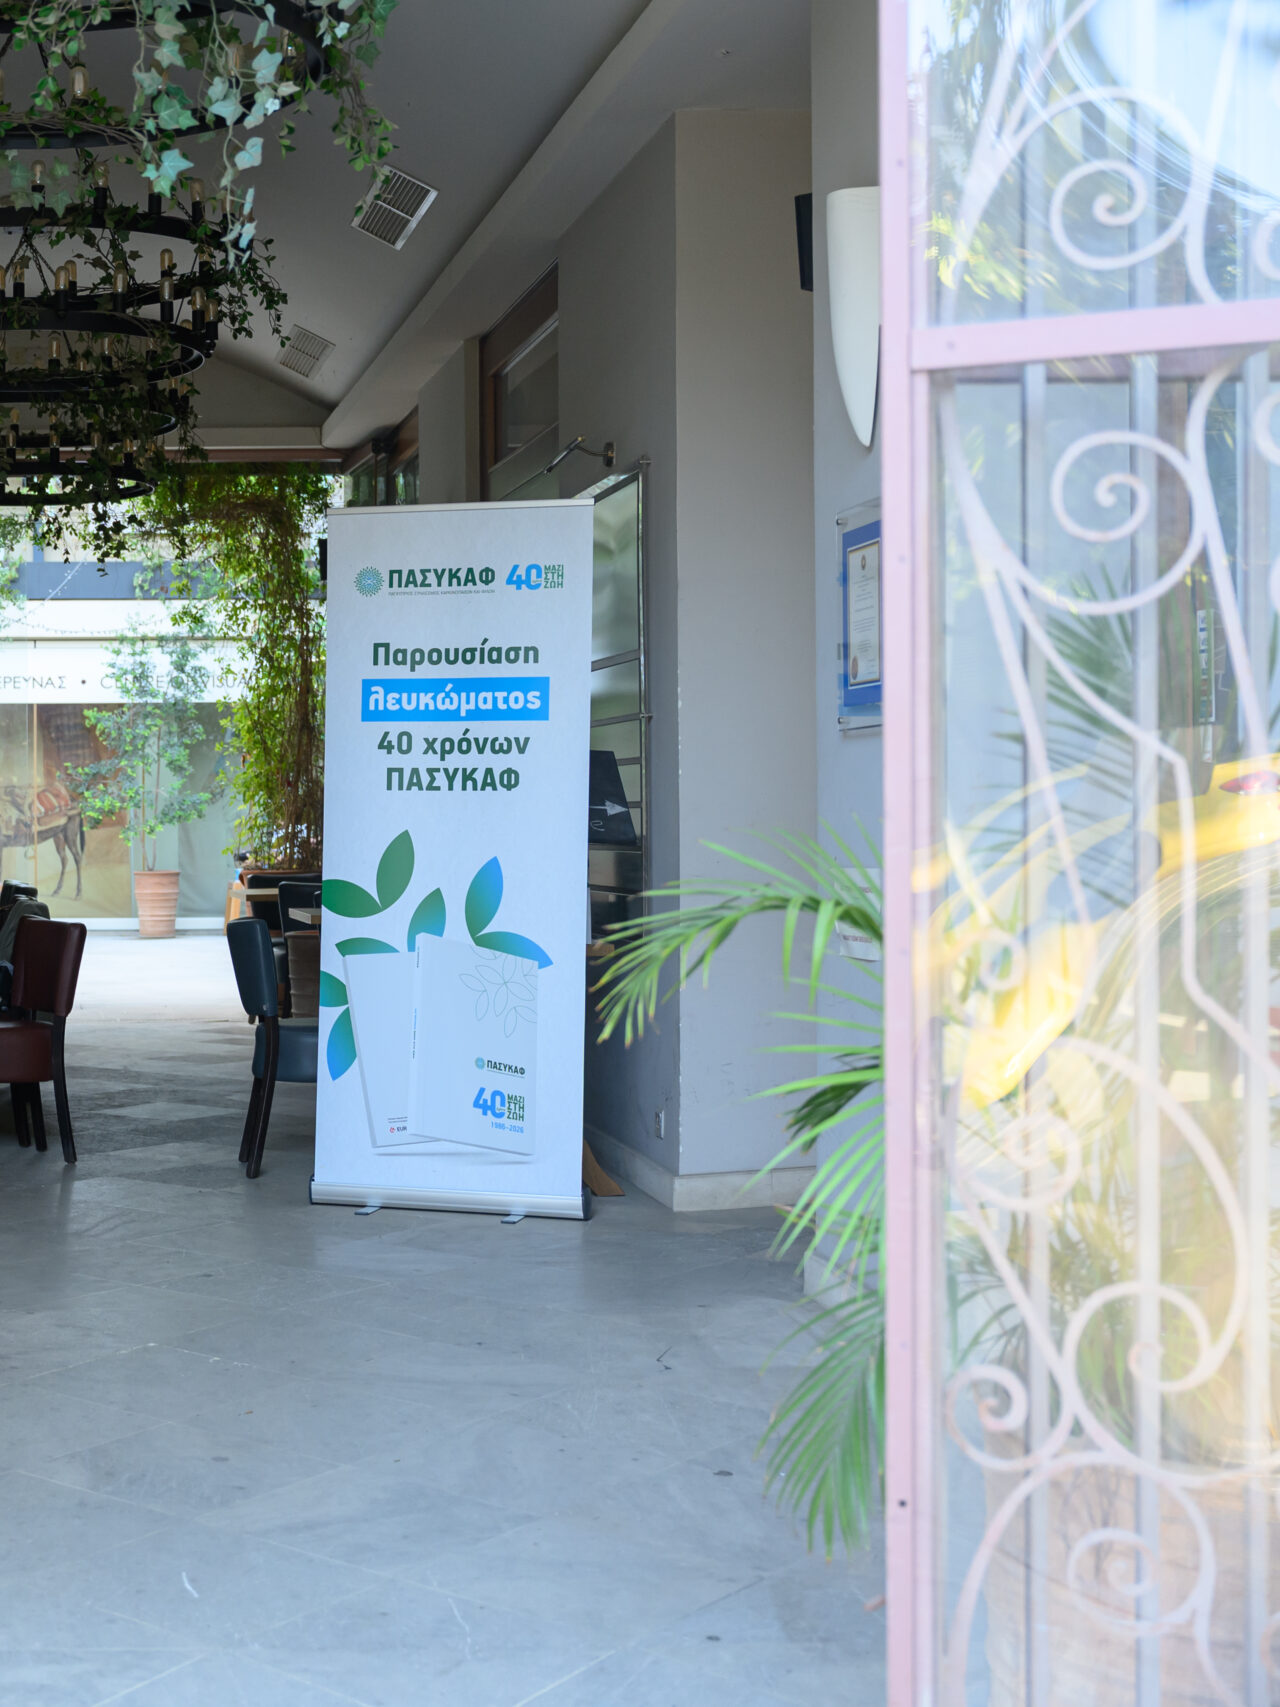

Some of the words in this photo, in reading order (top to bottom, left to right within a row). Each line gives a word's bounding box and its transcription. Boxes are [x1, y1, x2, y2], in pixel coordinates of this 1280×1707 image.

[388, 566, 496, 588] ΠΑΣΥΚΑΦ
[505, 563, 543, 590] 40
[543, 571, 564, 580] ΣΤΗ
[544, 564, 564, 572] ΜΑΖΙ
[543, 580, 564, 589] ΖΩΗ
[372, 637, 539, 672] Παρουσίαση
[369, 683, 541, 717] λευκώματος
[377, 731, 413, 755] 40
[422, 728, 531, 762] χρόνων
[386, 767, 520, 791] ΠΑΣΥΚΑΦ
[486, 1059, 526, 1076] ΠΑΣΥΚΑΦ
[472, 1086, 506, 1119] 40
[507, 1101, 525, 1113] ΣΤΗ
[506, 1110, 525, 1122] ΖΩΗ
